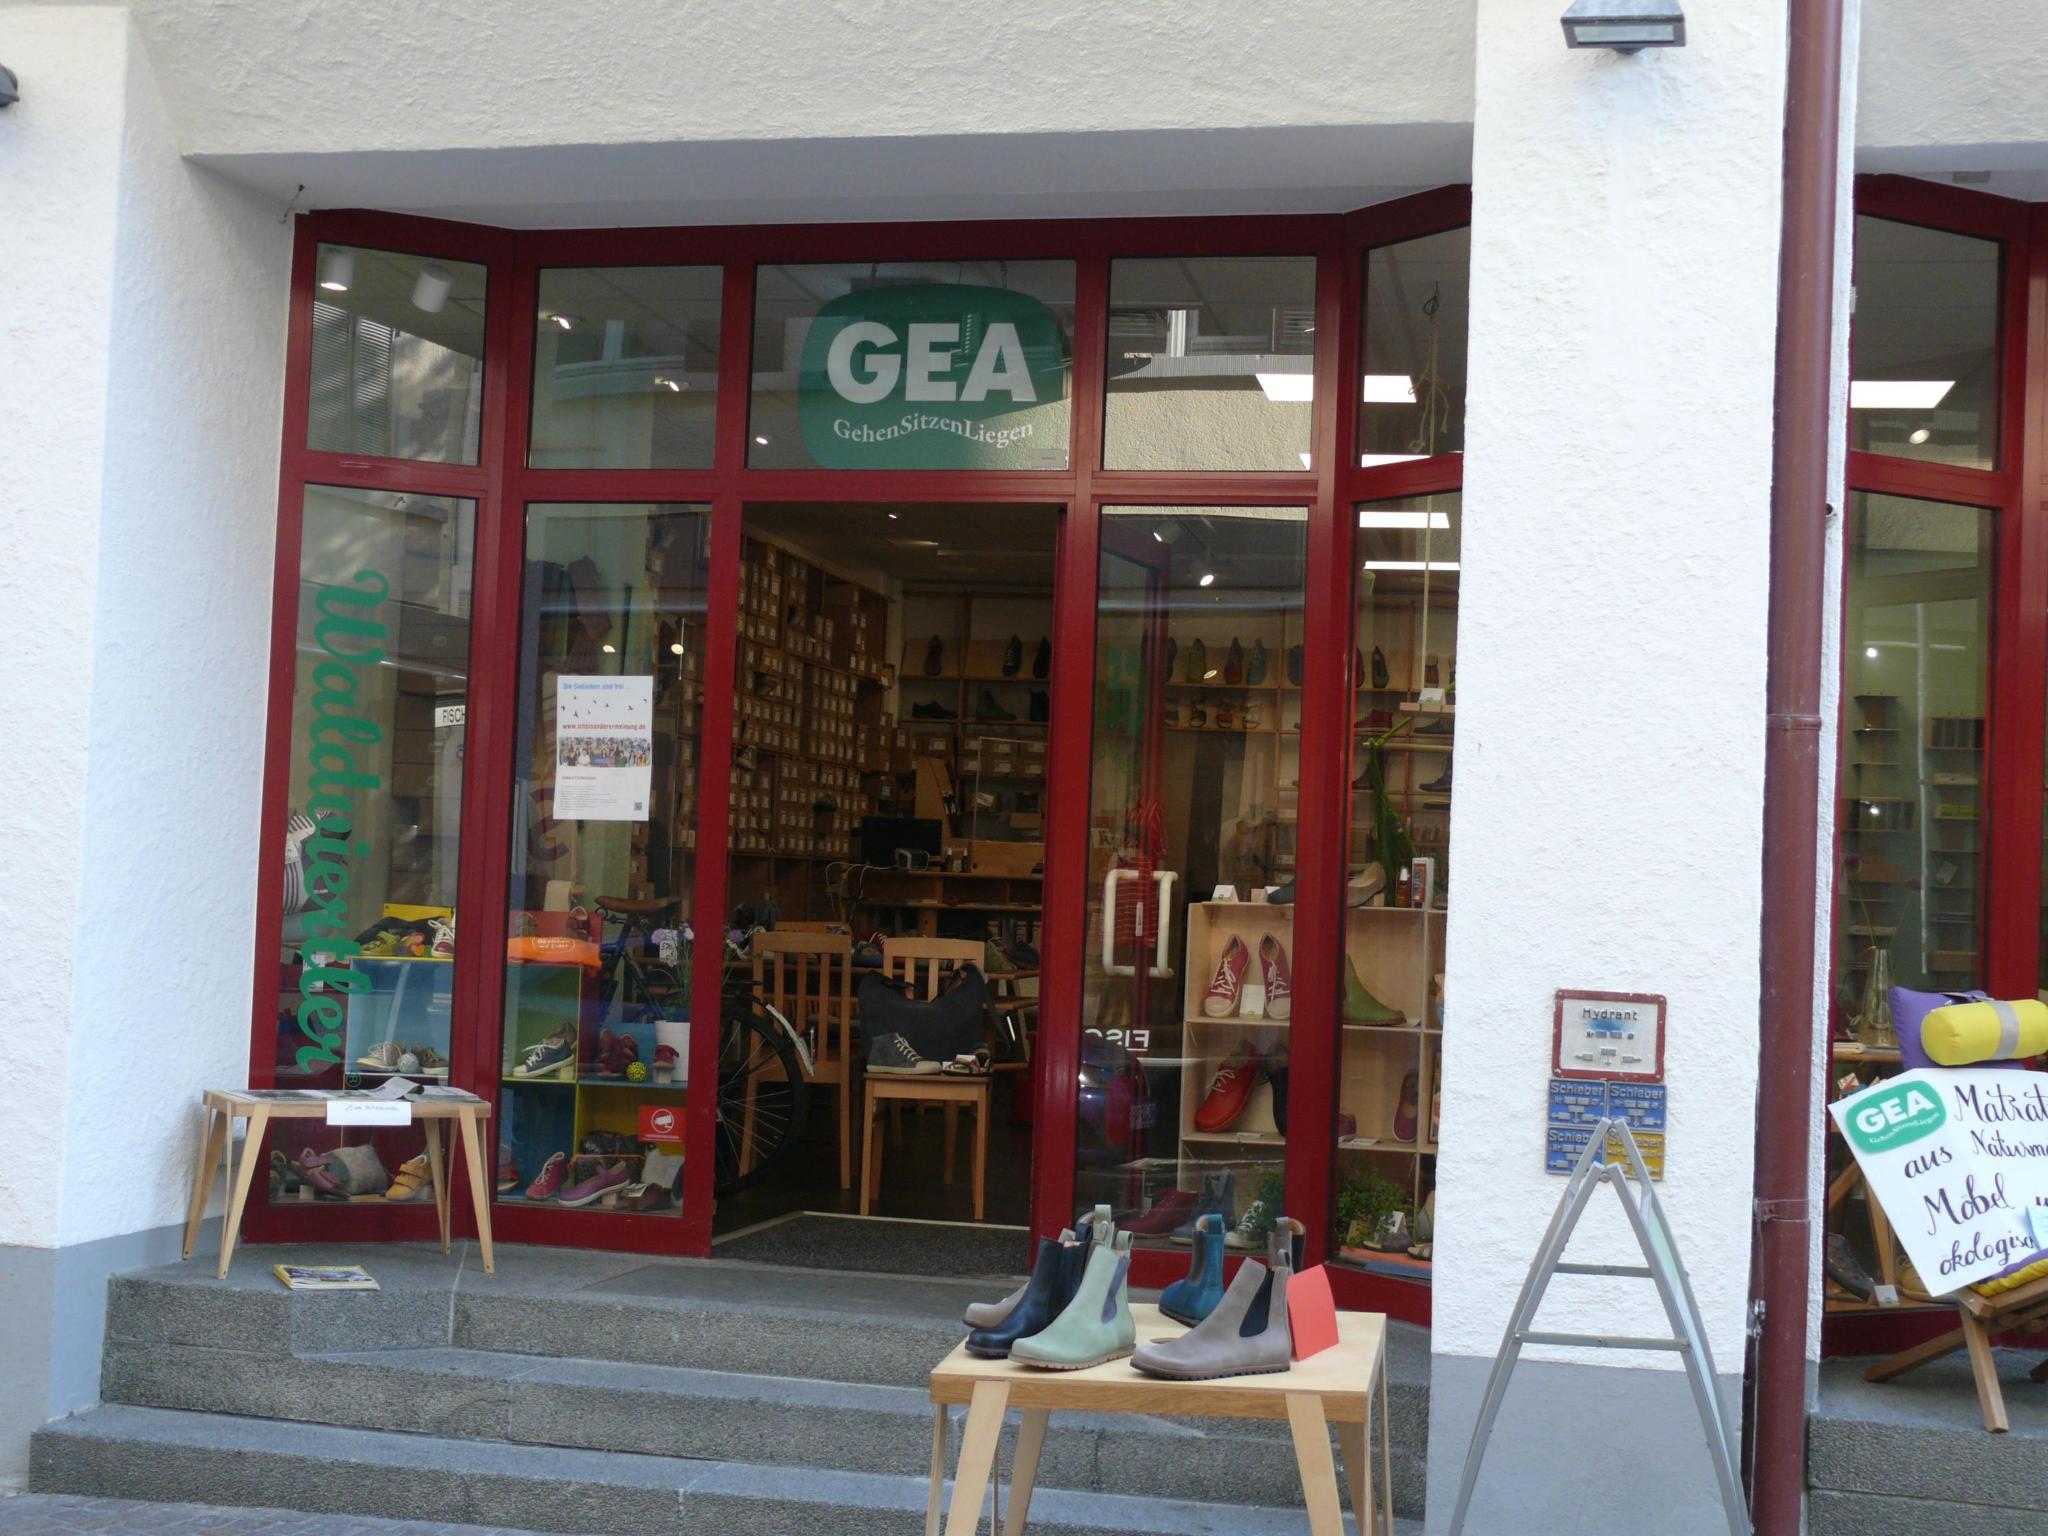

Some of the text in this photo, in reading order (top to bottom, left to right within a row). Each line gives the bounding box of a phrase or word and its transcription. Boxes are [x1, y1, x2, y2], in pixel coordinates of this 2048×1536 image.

[827, 321, 1038, 404] GEA
[833, 413, 1034, 448] GehenSitzenLiegen
[295, 568, 389, 1074] Waldviertler
[1583, 1008, 1638, 1020] Hydrant
[1550, 1082, 1603, 1097] Schieber
[1610, 1085, 1664, 1099] Schieber
[1856, 1090, 1936, 1133] GEA
[1548, 1130, 1592, 1144] Schieb
[1904, 1146, 1952, 1178] aus
[1923, 1172, 2016, 1236] Möbel
